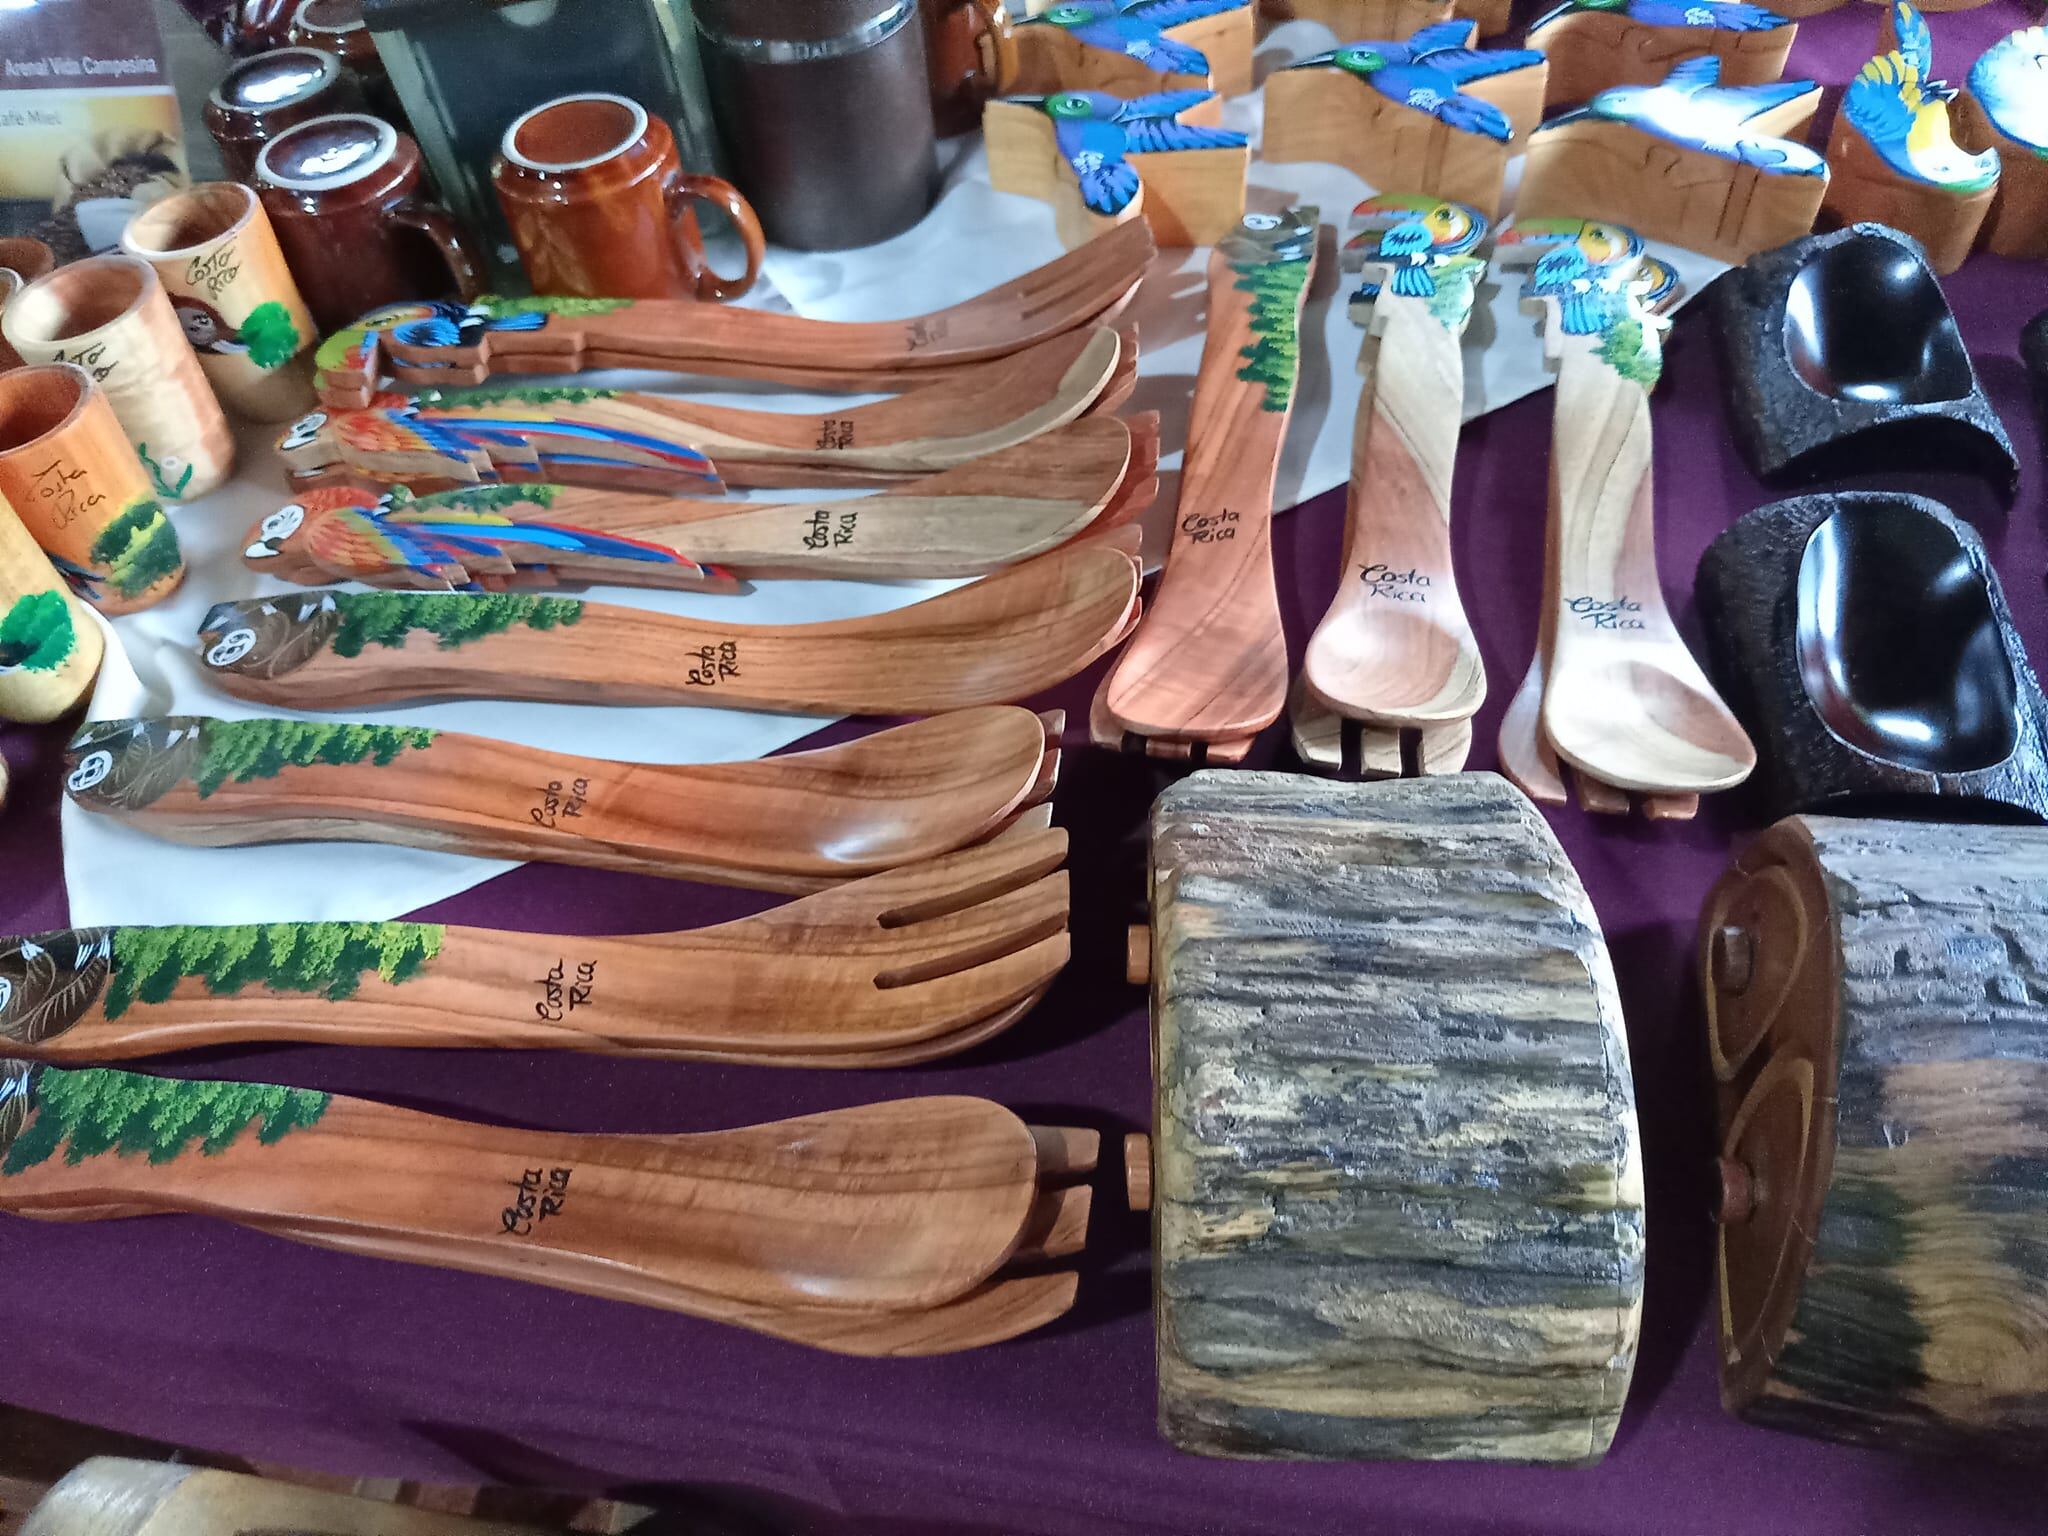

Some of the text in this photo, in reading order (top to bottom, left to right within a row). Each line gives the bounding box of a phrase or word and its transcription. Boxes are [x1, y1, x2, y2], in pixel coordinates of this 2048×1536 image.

[803, 510, 831, 550] Costa
[834, 512, 858, 547] Rica
[1181, 508, 1240, 532] Costa
[1186, 528, 1236, 545] Rica
[1358, 564, 1431, 587] Costa
[1370, 583, 1426, 603] Rica
[1563, 594, 1642, 613] Costa
[1580, 612, 1645, 629] Rica
[684, 645, 716, 686] Costa
[718, 641, 742, 682] Rica
[530, 780, 563, 829] Costa
[561, 778, 592, 818] Rica
[534, 957, 564, 1021] Costa
[569, 960, 598, 1012] Rica
[496, 1167, 543, 1236] Costa
[539, 1166, 573, 1222] Rica
